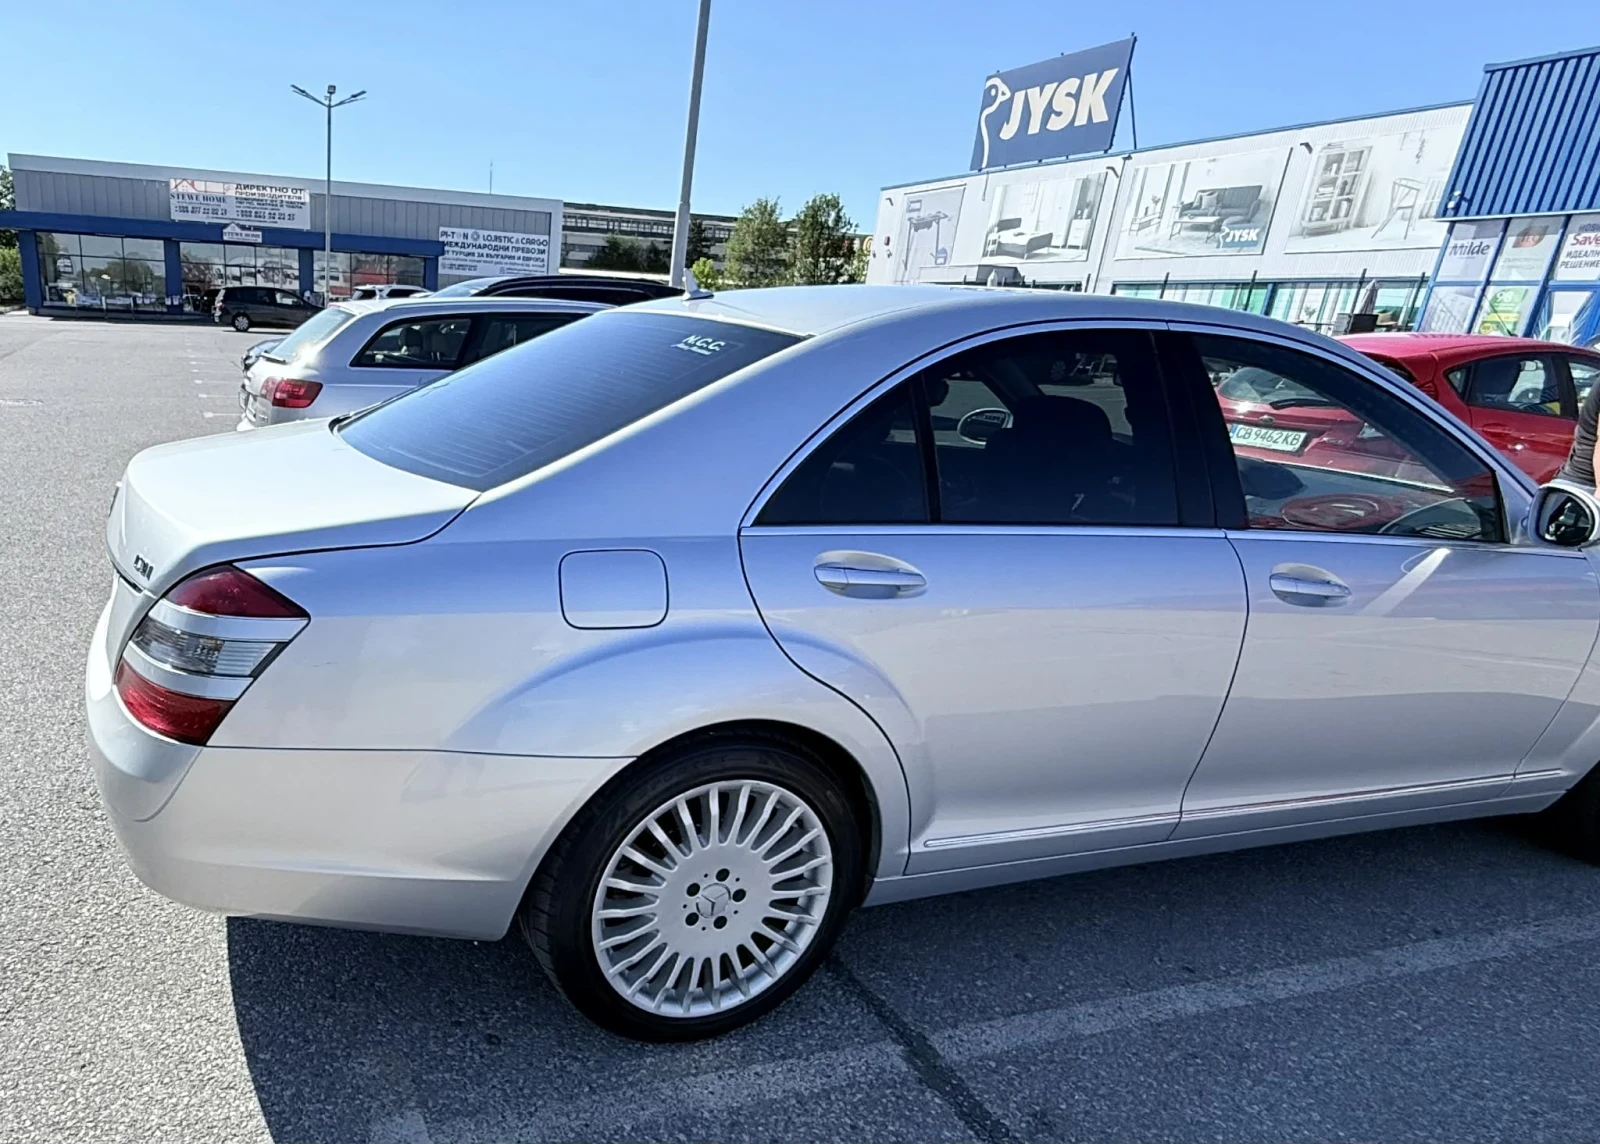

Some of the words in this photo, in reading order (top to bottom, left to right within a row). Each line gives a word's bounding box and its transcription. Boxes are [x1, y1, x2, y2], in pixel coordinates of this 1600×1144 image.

[999, 68, 1119, 140] JYSK
[235, 184, 288, 193] ДИРЕКТНО
[202, 195, 227, 203] HOME
[235, 191, 302, 200] ПРОИЗВОДИТЕЛЯ
[1225, 228, 1260, 242] JYSK
[521, 238, 548, 246] CARGO
[512, 246, 546, 255] ПРЕВОЗИ
[1449, 241, 1490, 256] Milde
[1236, 427, 1252, 439] CB
[1254, 430, 1281, 444] 9462
[1281, 432, 1301, 446] KB
